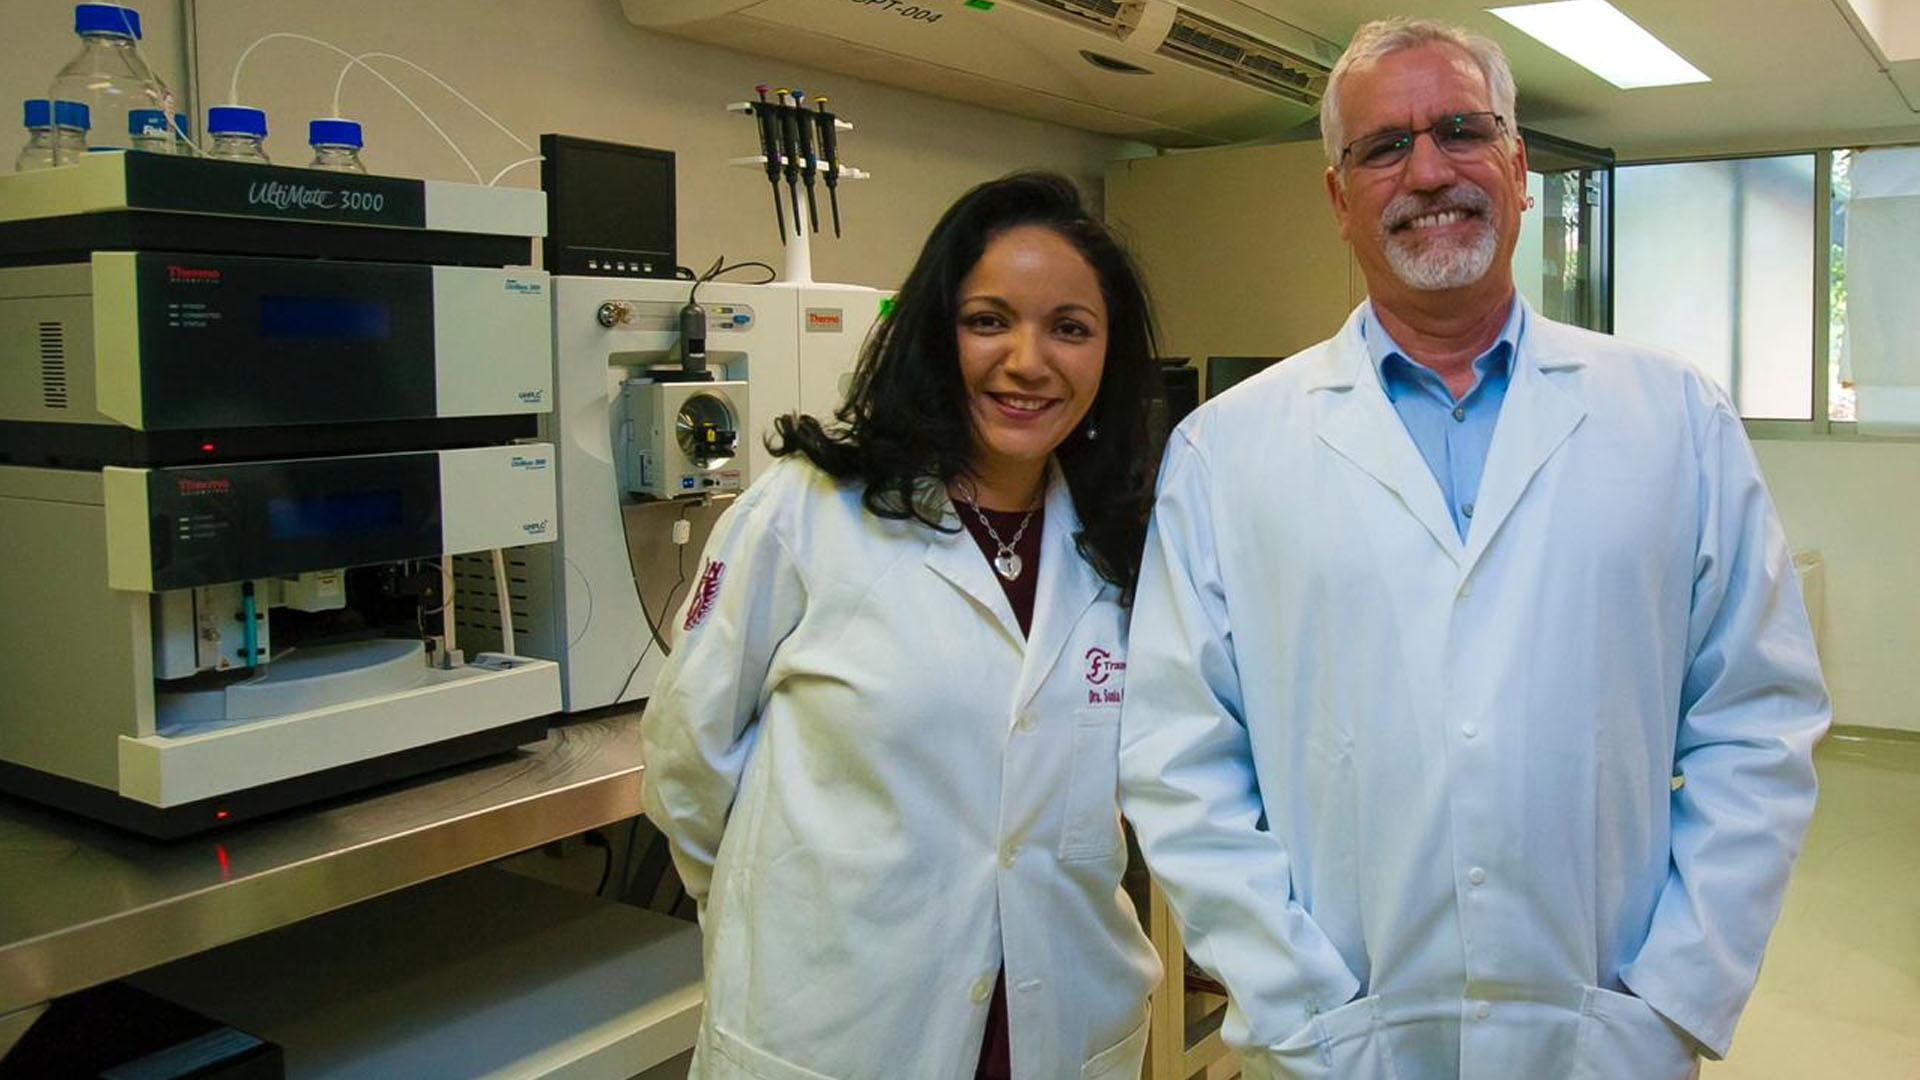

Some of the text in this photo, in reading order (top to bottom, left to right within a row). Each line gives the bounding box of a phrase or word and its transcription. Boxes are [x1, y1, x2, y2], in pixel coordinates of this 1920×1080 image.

[851, 0, 943, 22] PT-004
[249, 181, 384, 212] UltiMate 3000
